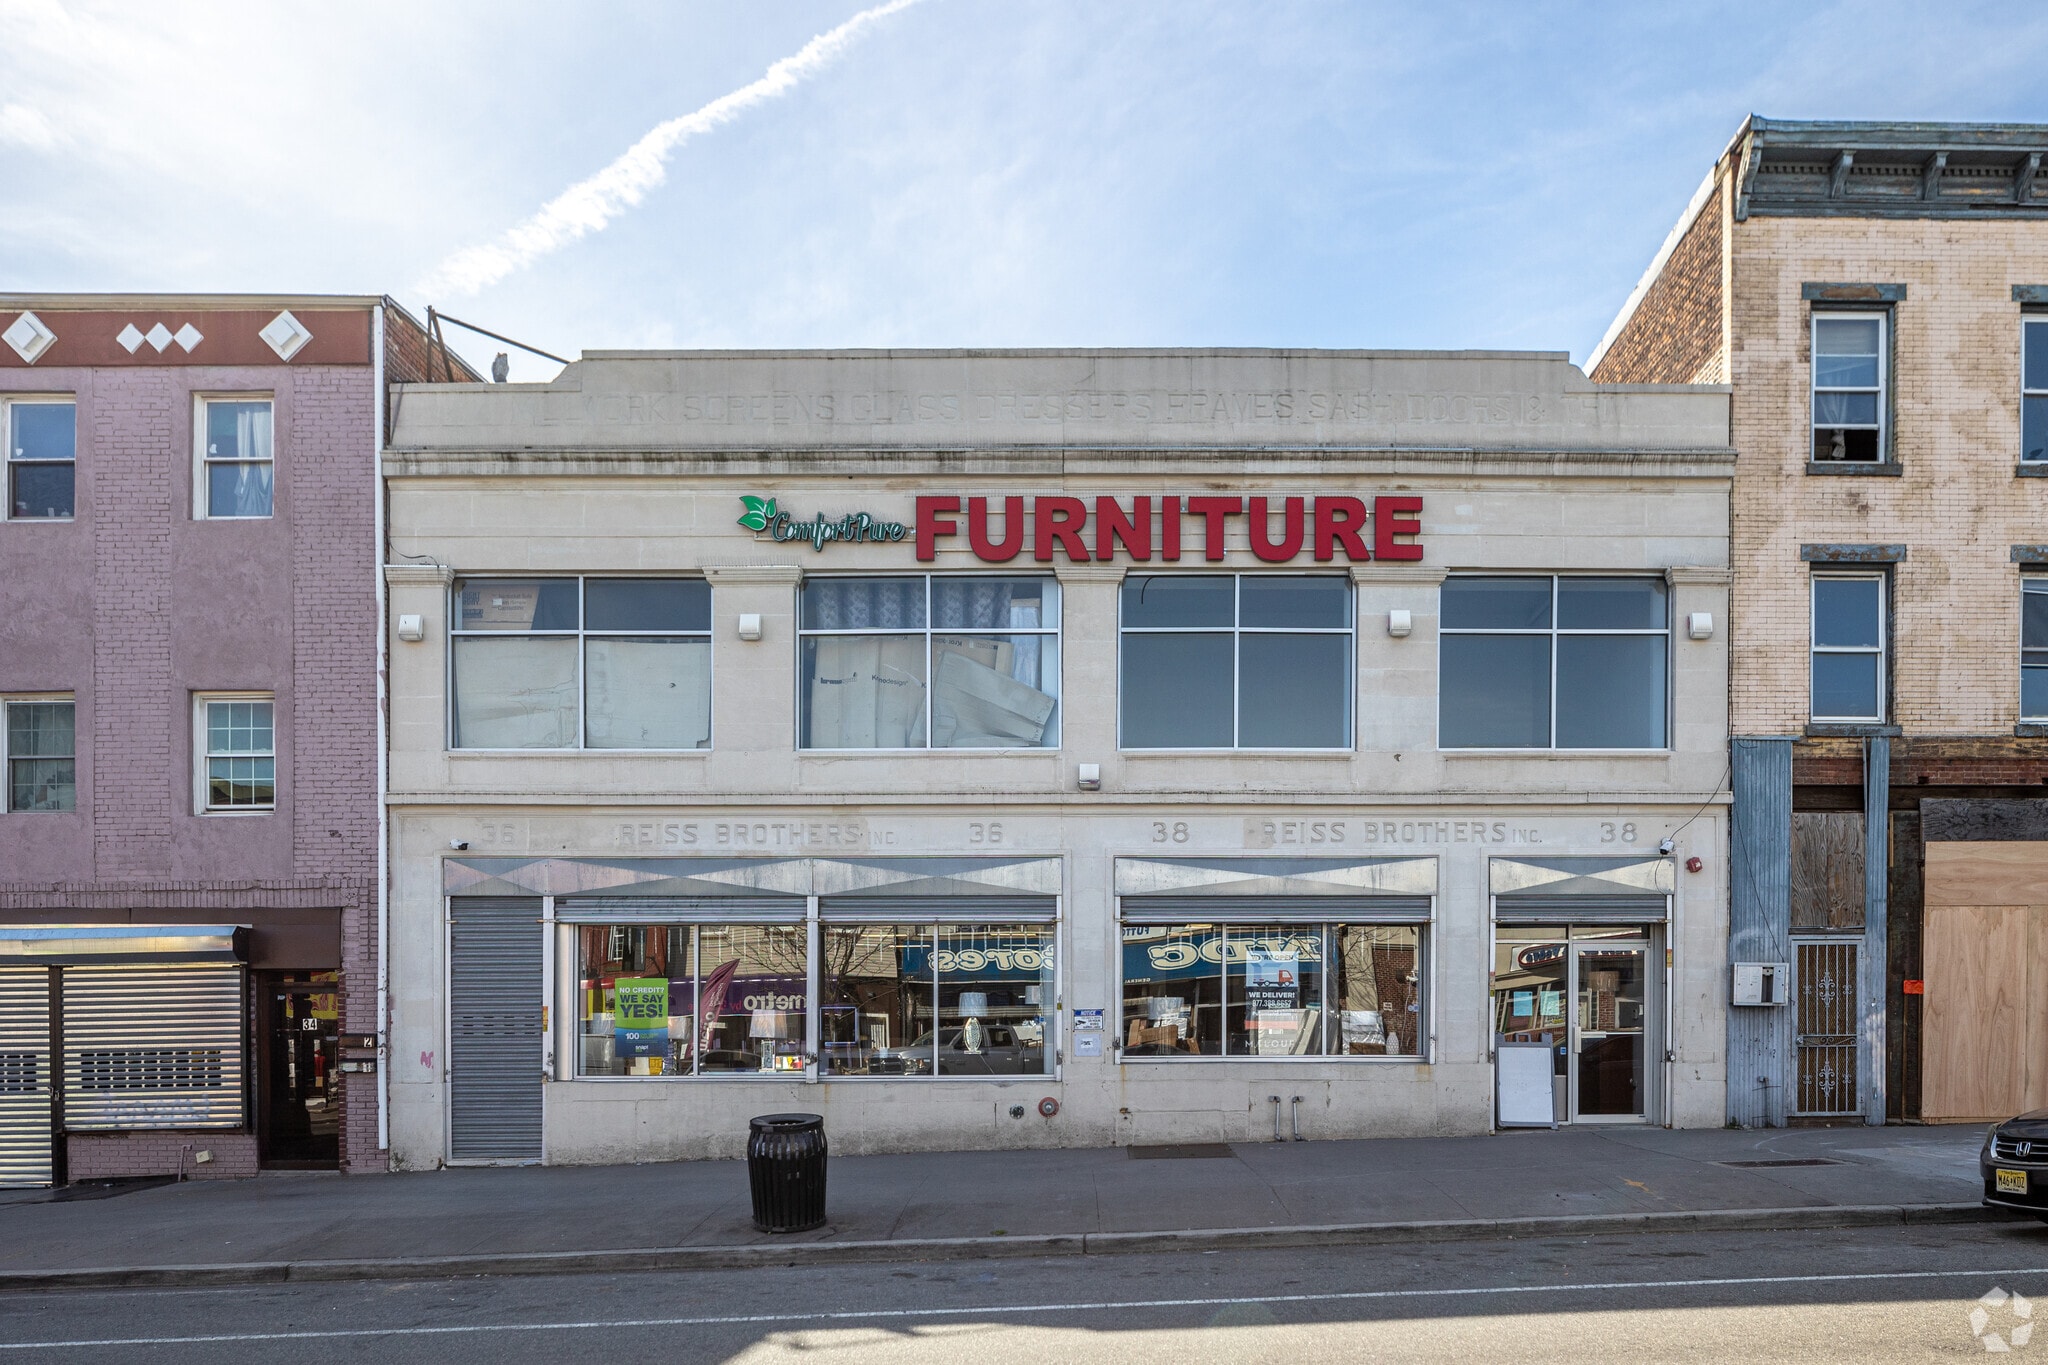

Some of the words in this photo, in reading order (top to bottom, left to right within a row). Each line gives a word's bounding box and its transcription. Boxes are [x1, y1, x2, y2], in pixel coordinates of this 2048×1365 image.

[915, 496, 1424, 562] FURNITURE
[617, 823, 699, 844] REISS
[715, 823, 862, 845] BROTHERS
[968, 822, 1004, 844] 36
[1152, 821, 1191, 844] 38
[1261, 821, 1346, 844] REISS
[1363, 821, 1506, 844] BROTHERS
[1600, 821, 1639, 844] 38
[619, 994, 638, 1004] WE
[641, 994, 665, 1004] SAY
[619, 1004, 664, 1018] YES!
[303, 1019, 317, 1030] 34
[625, 1032, 640, 1040] 100
